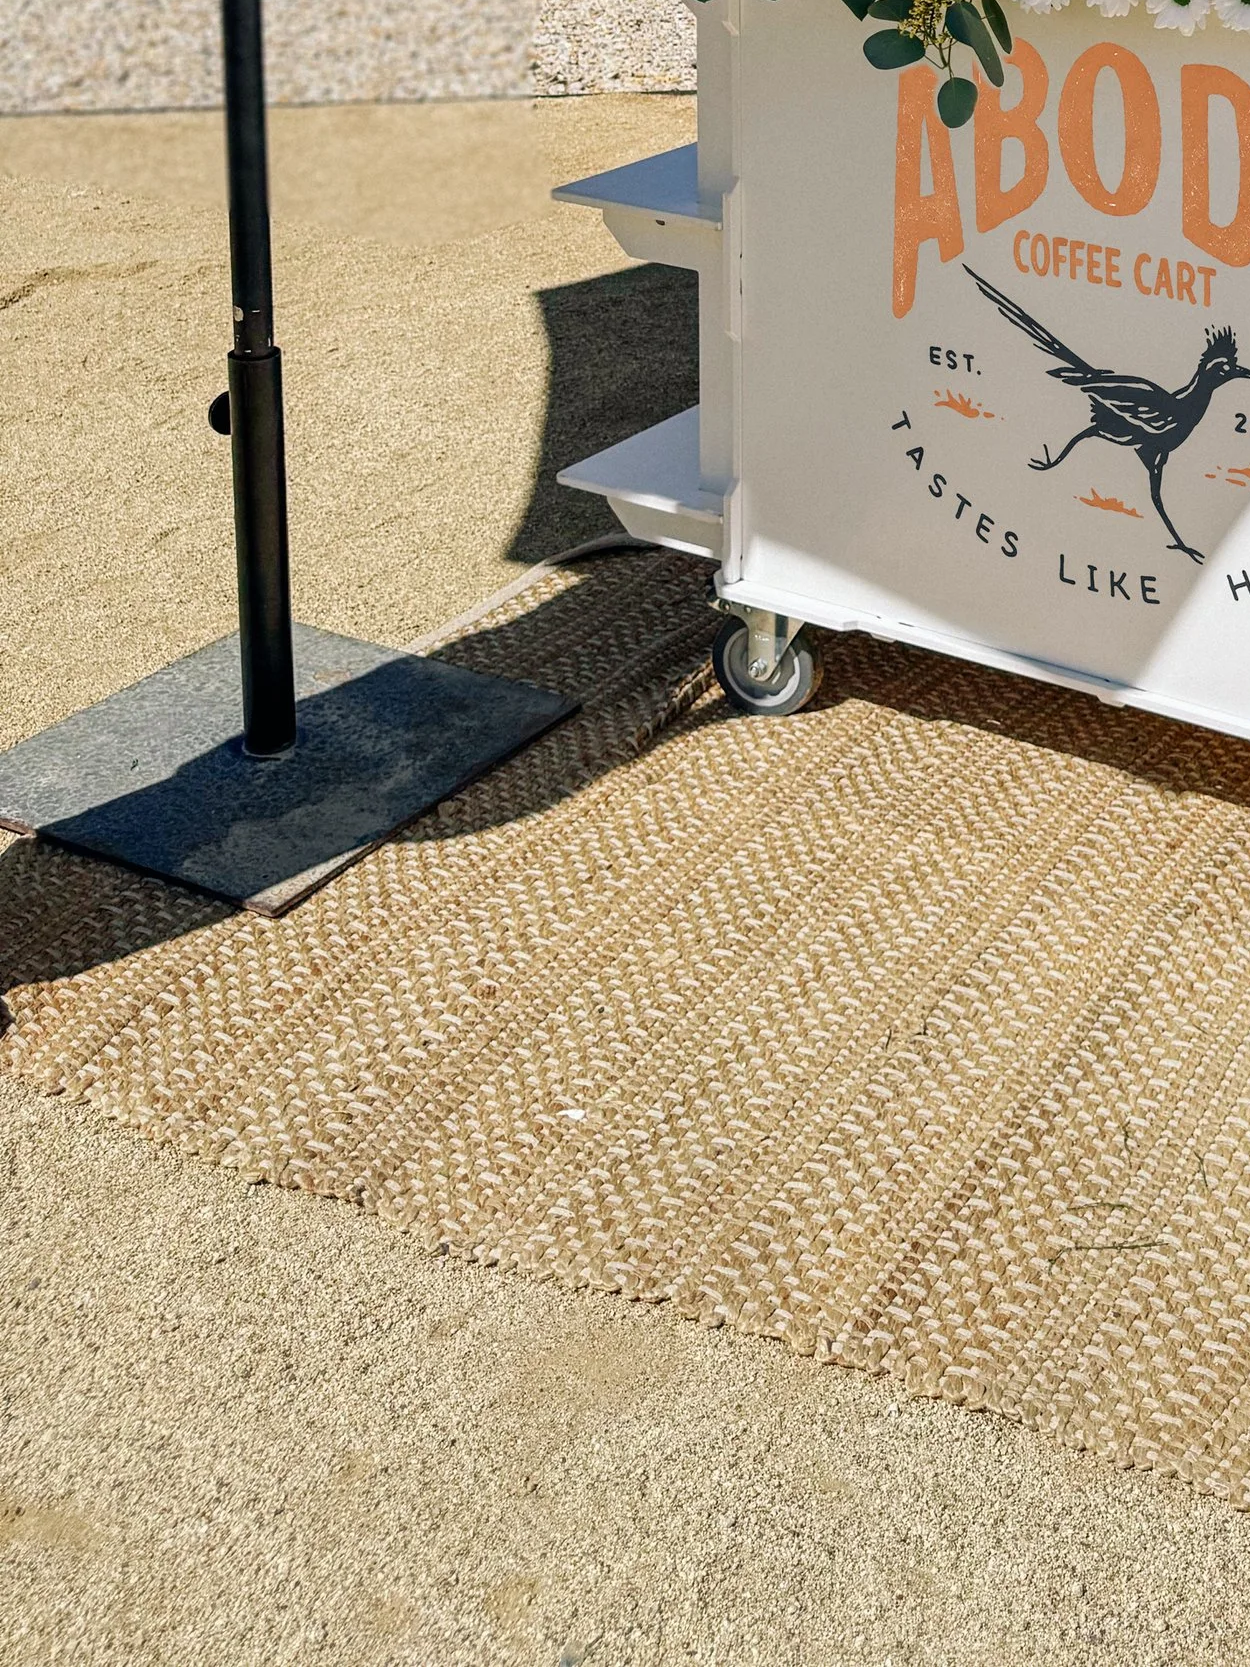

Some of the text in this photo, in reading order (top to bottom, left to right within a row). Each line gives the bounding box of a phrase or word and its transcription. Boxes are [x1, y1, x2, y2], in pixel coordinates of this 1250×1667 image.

[1012, 229, 1217, 309] COFFEE CART
[928, 345, 983, 376] EST.
[890, 411, 1020, 558] TASTES
[1057, 554, 1161, 605] LIKE
